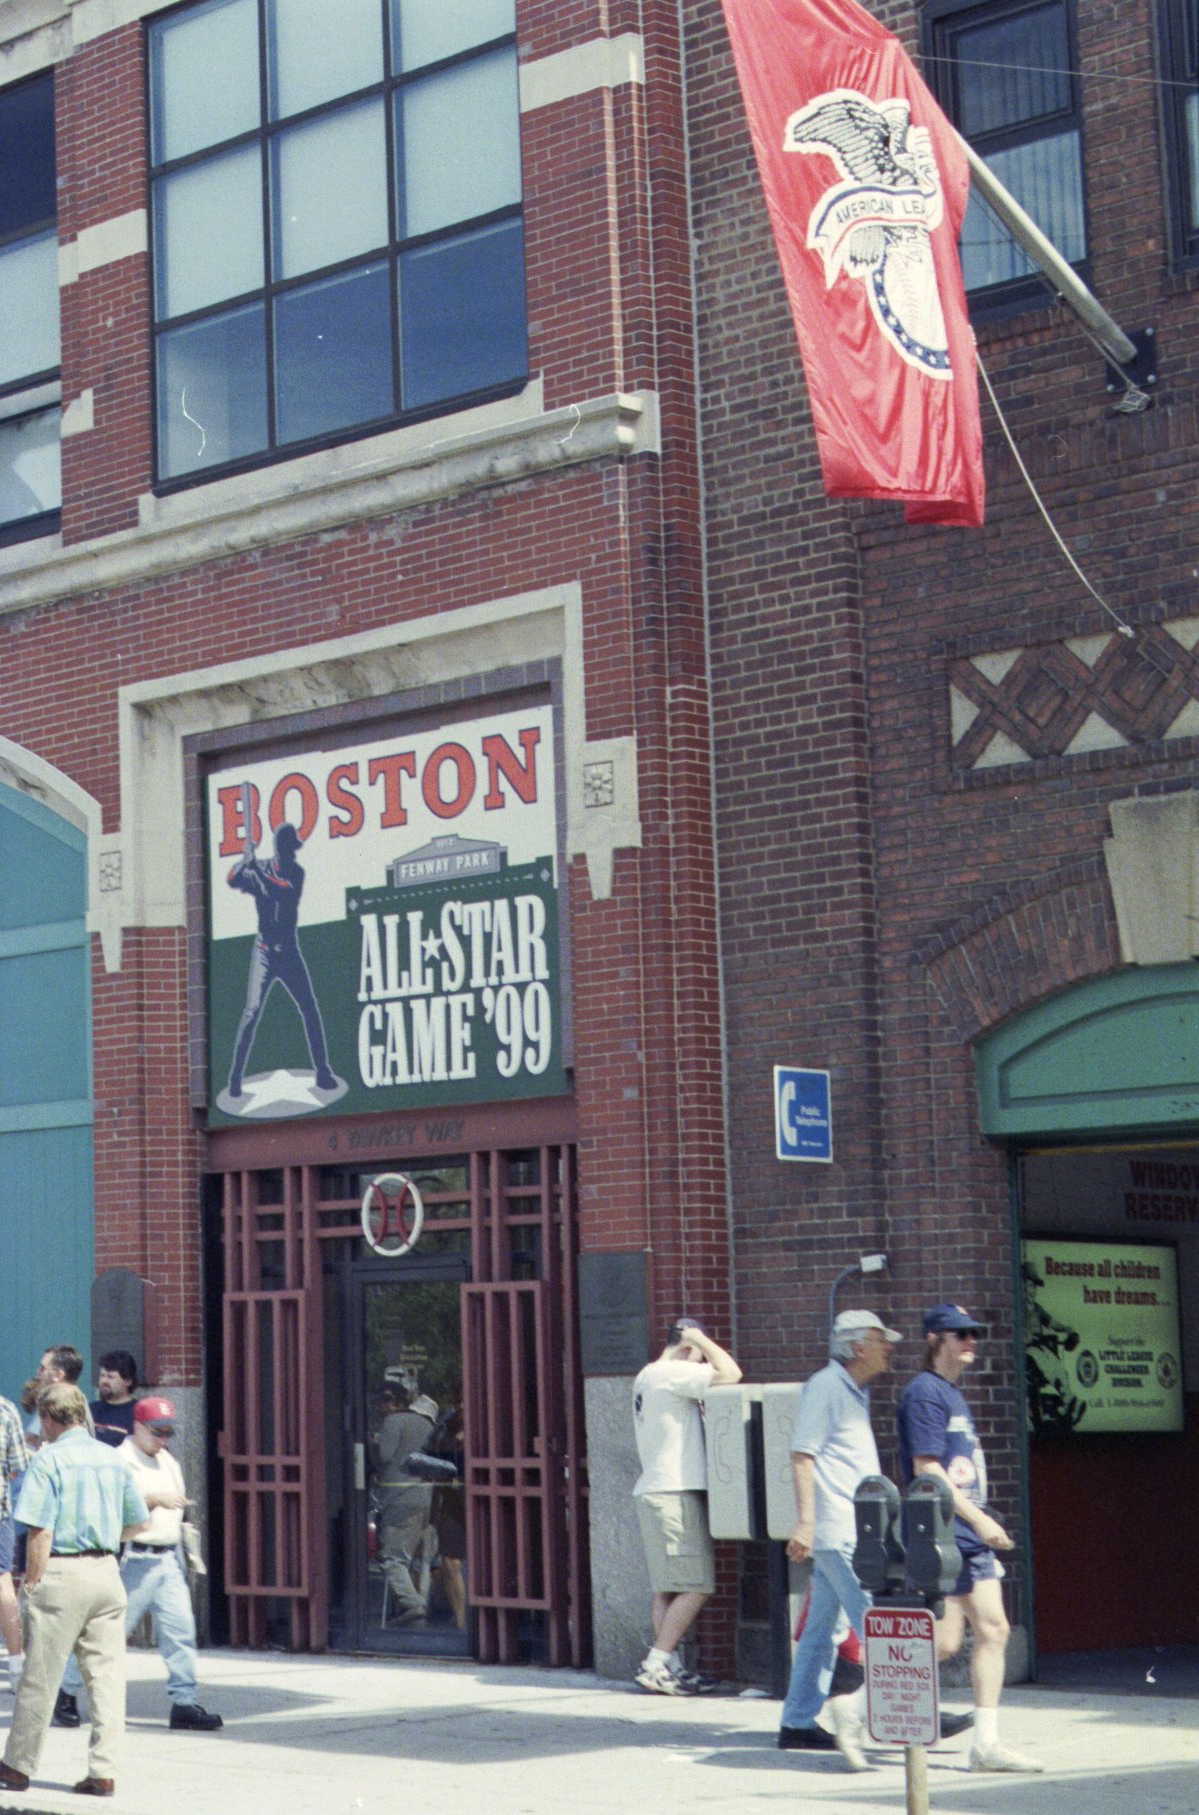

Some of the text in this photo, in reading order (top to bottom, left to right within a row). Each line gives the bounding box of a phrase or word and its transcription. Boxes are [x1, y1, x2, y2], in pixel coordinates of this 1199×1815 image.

[835, 198, 925, 224] AMERICAN LE
[218, 726, 542, 857] BOSTON
[401, 851, 490, 879] FENWAY PARK
[358, 982, 552, 1088] GAME '99
[800, 1105, 821, 1116] Public
[1124, 1192, 1199, 1222] RESERV
[1044, 1256, 1161, 1280] Because all children
[1083, 1284, 1112, 1304] have
[867, 1616, 931, 1637] TOW ZONE
[888, 1645, 913, 1662] NO
[872, 1664, 931, 1680] STOPPING
[872, 1680, 898, 1690] DURING
[890, 1703, 915, 1713] GAMES
